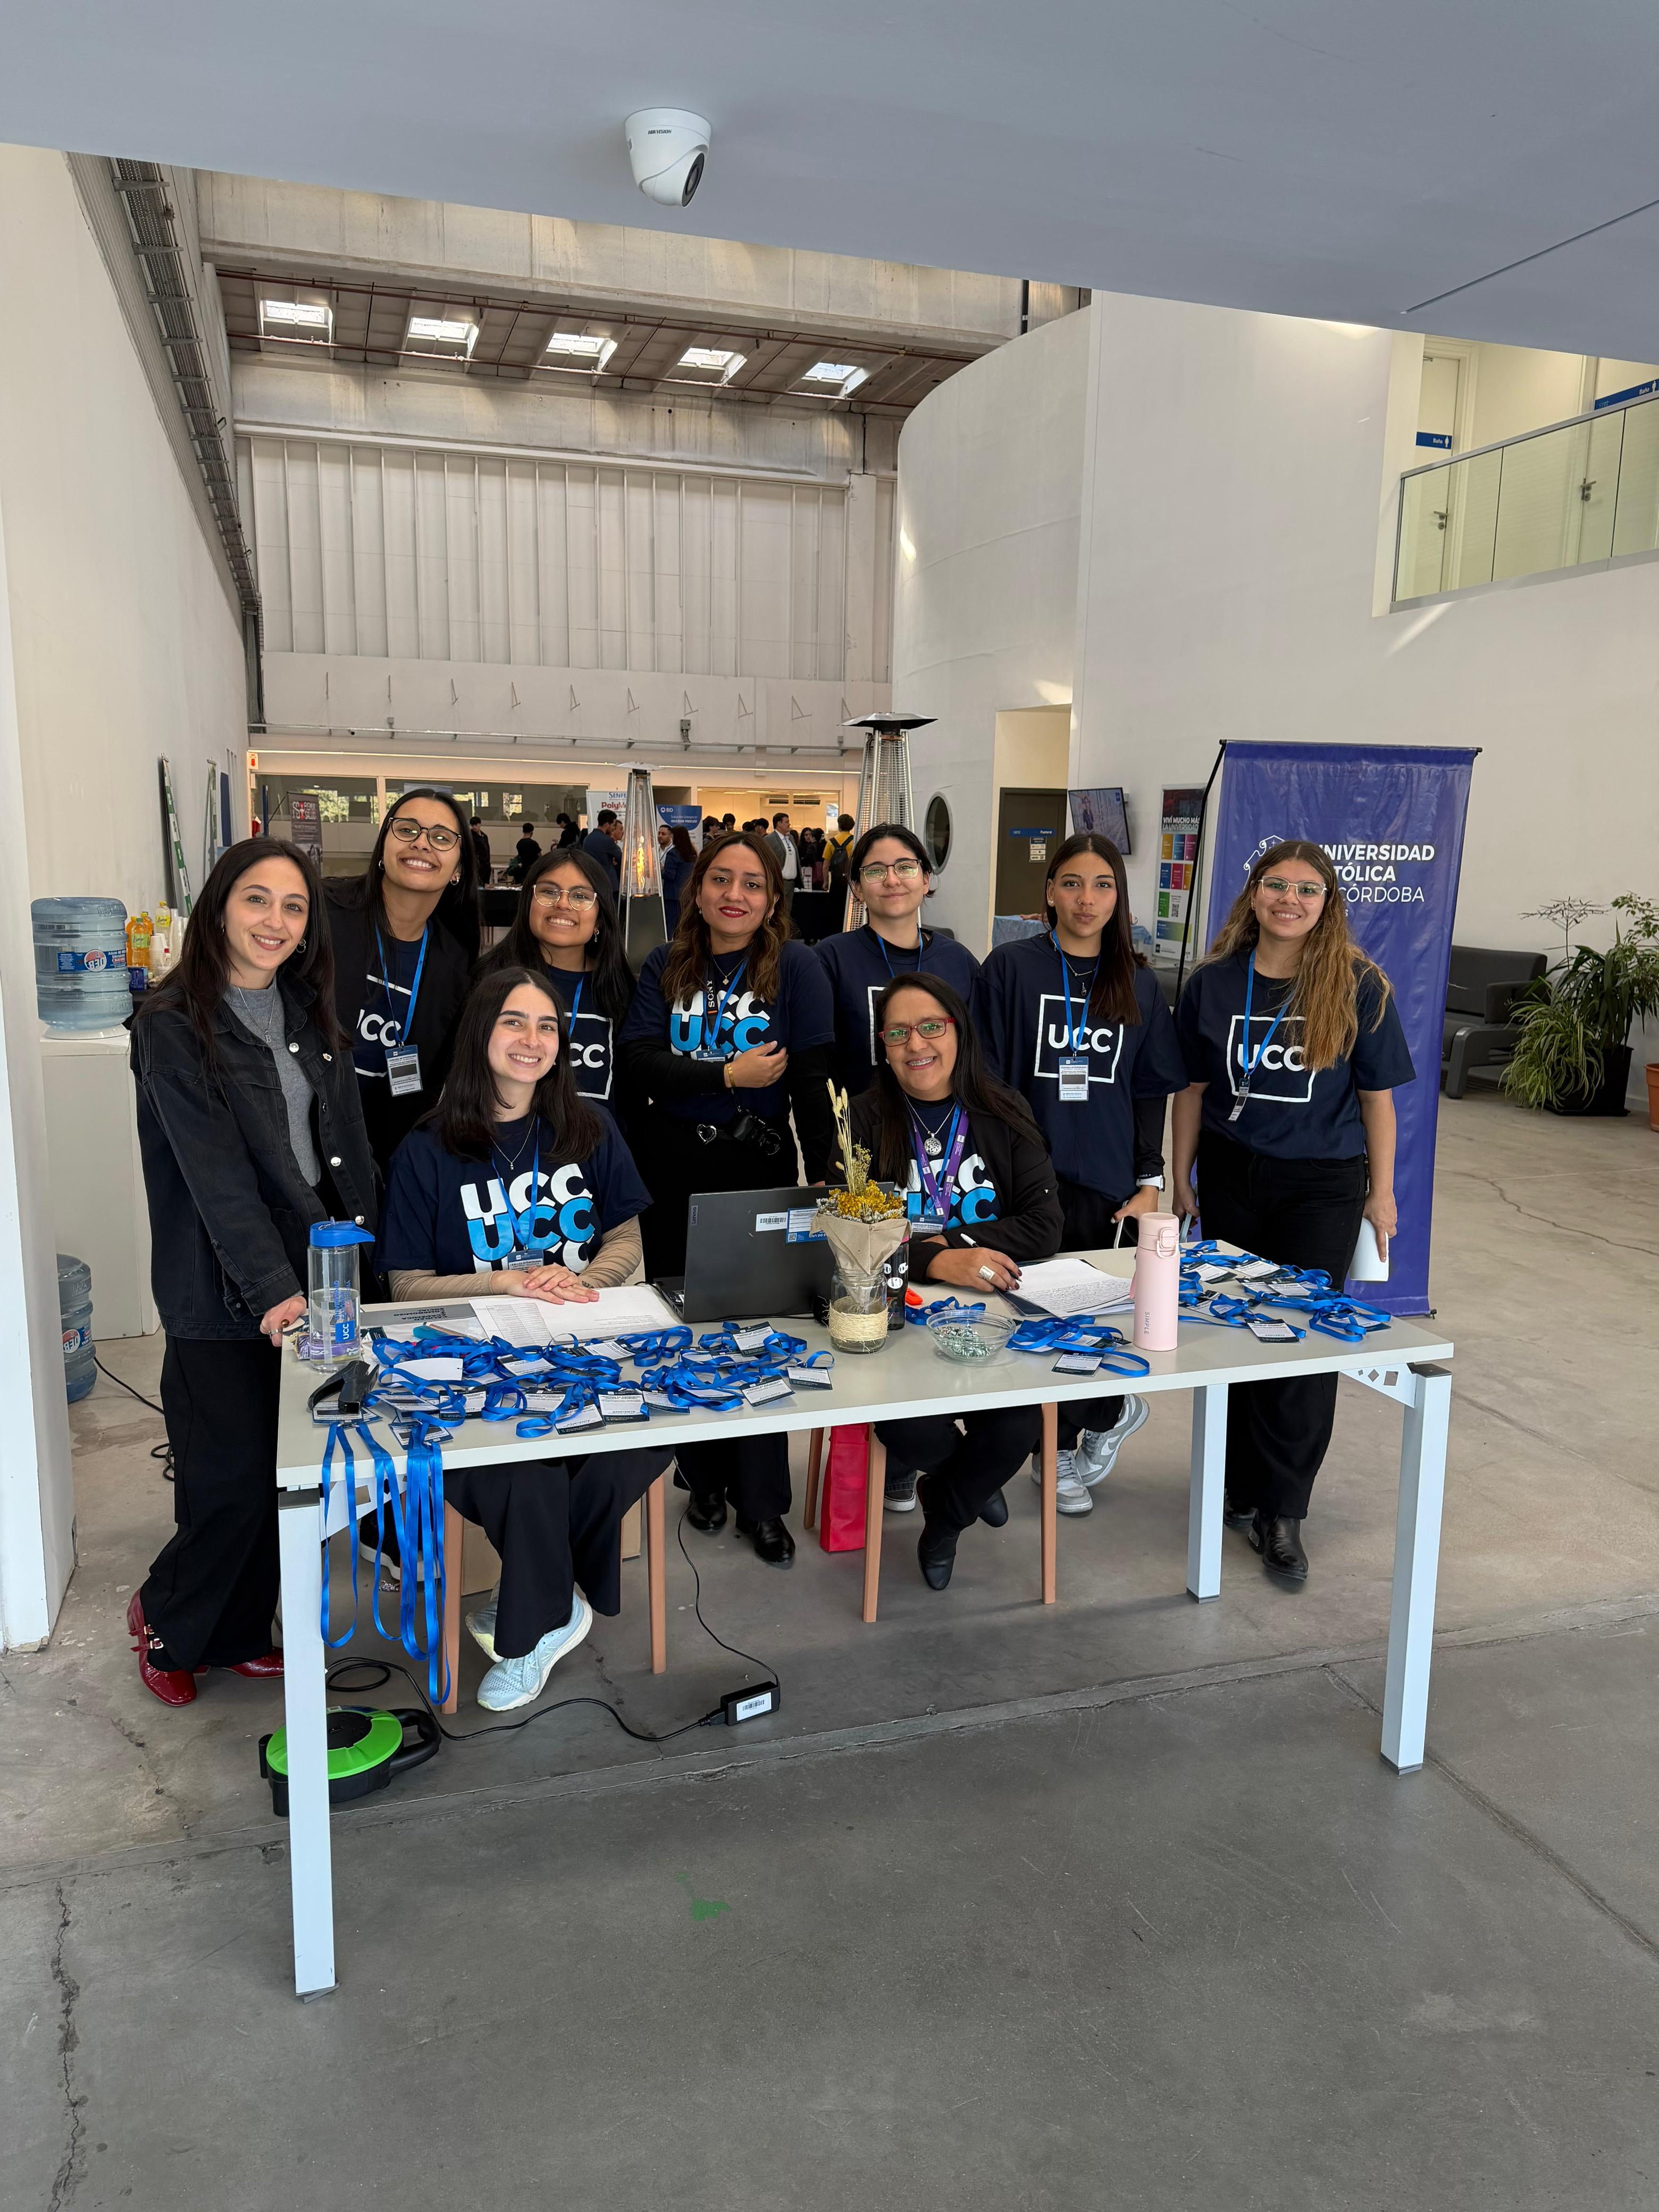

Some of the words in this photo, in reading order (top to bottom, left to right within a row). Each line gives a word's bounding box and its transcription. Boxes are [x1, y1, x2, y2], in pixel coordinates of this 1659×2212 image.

[1163, 815, 1173, 824] VIVÍ
[1319, 844, 1435, 861] NIVERSIDAD
[1334, 862, 1396, 882] TÓLICA
[356, 1009, 401, 1047] CC
[1048, 1024, 1113, 1053] UCC
[569, 1042, 606, 1068] CC
[460, 1163, 593, 1226] UCC
[467, 1197, 596, 1261] UCC
